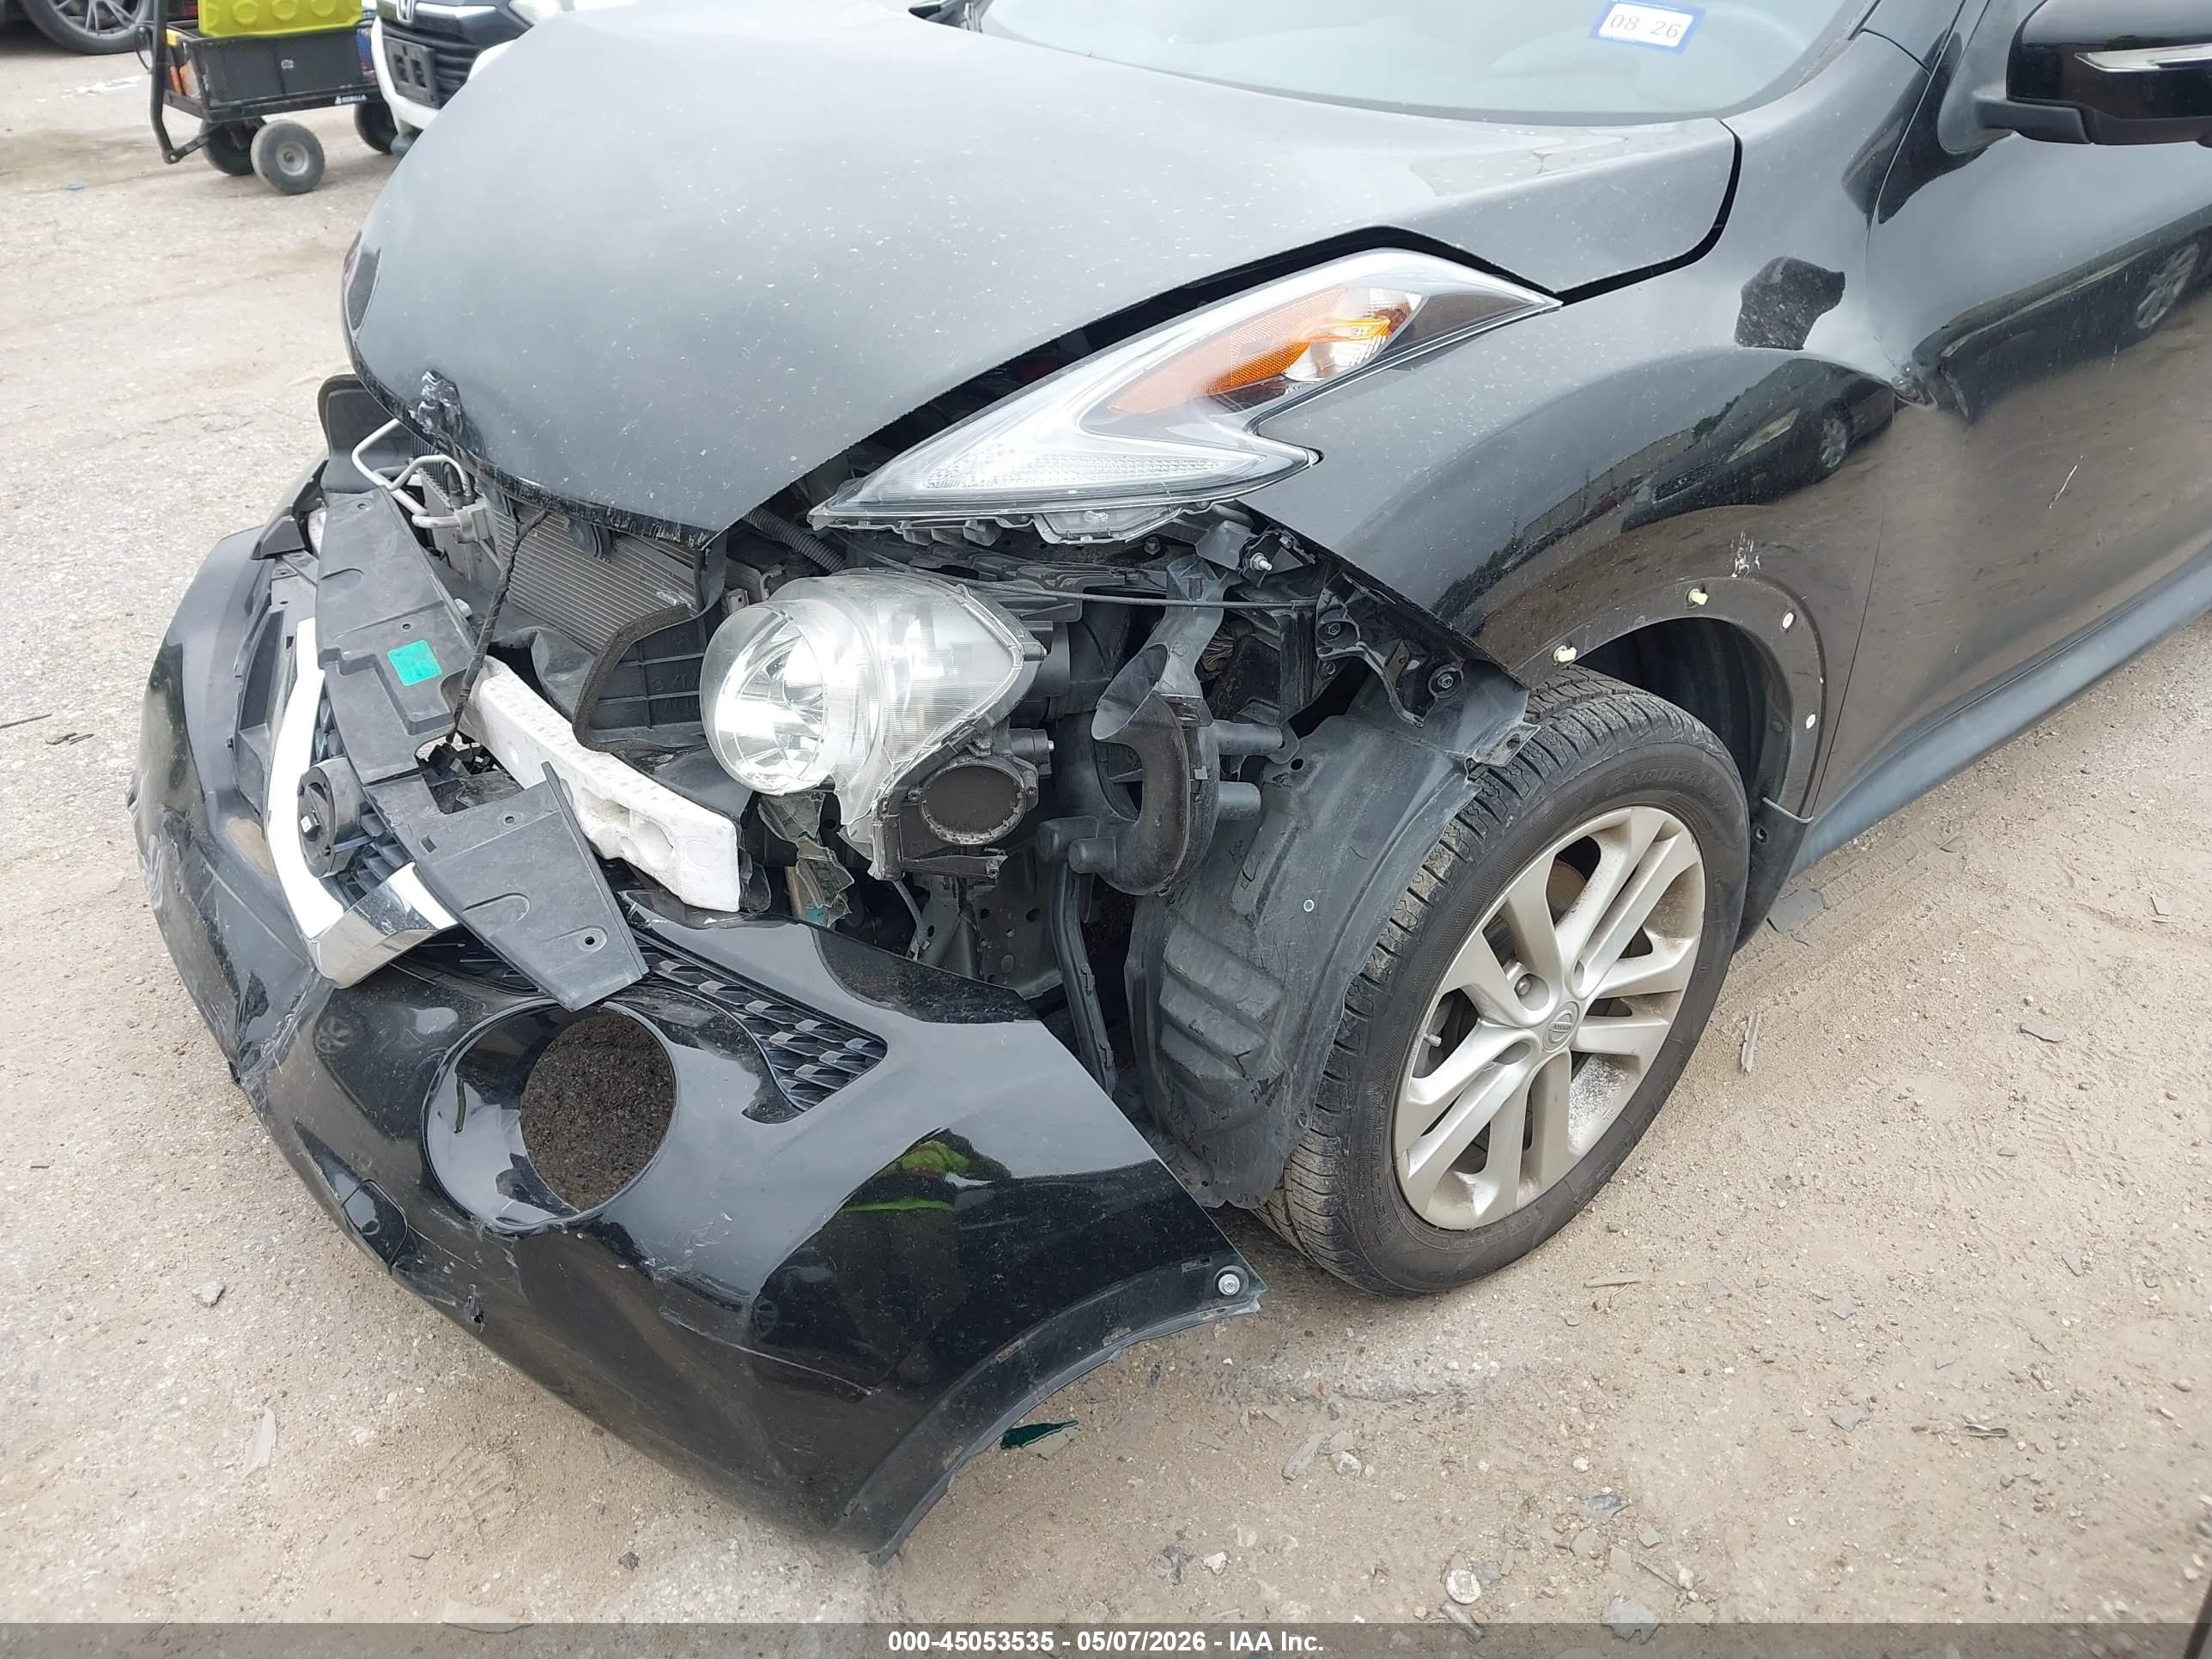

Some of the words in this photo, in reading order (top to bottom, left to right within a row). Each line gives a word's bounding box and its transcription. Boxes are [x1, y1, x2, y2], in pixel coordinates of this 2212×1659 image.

[1610, 14, 1639, 30] 08
[1650, 21, 1681, 39] 26
[1553, 1023, 1571, 1031] NISSAN
